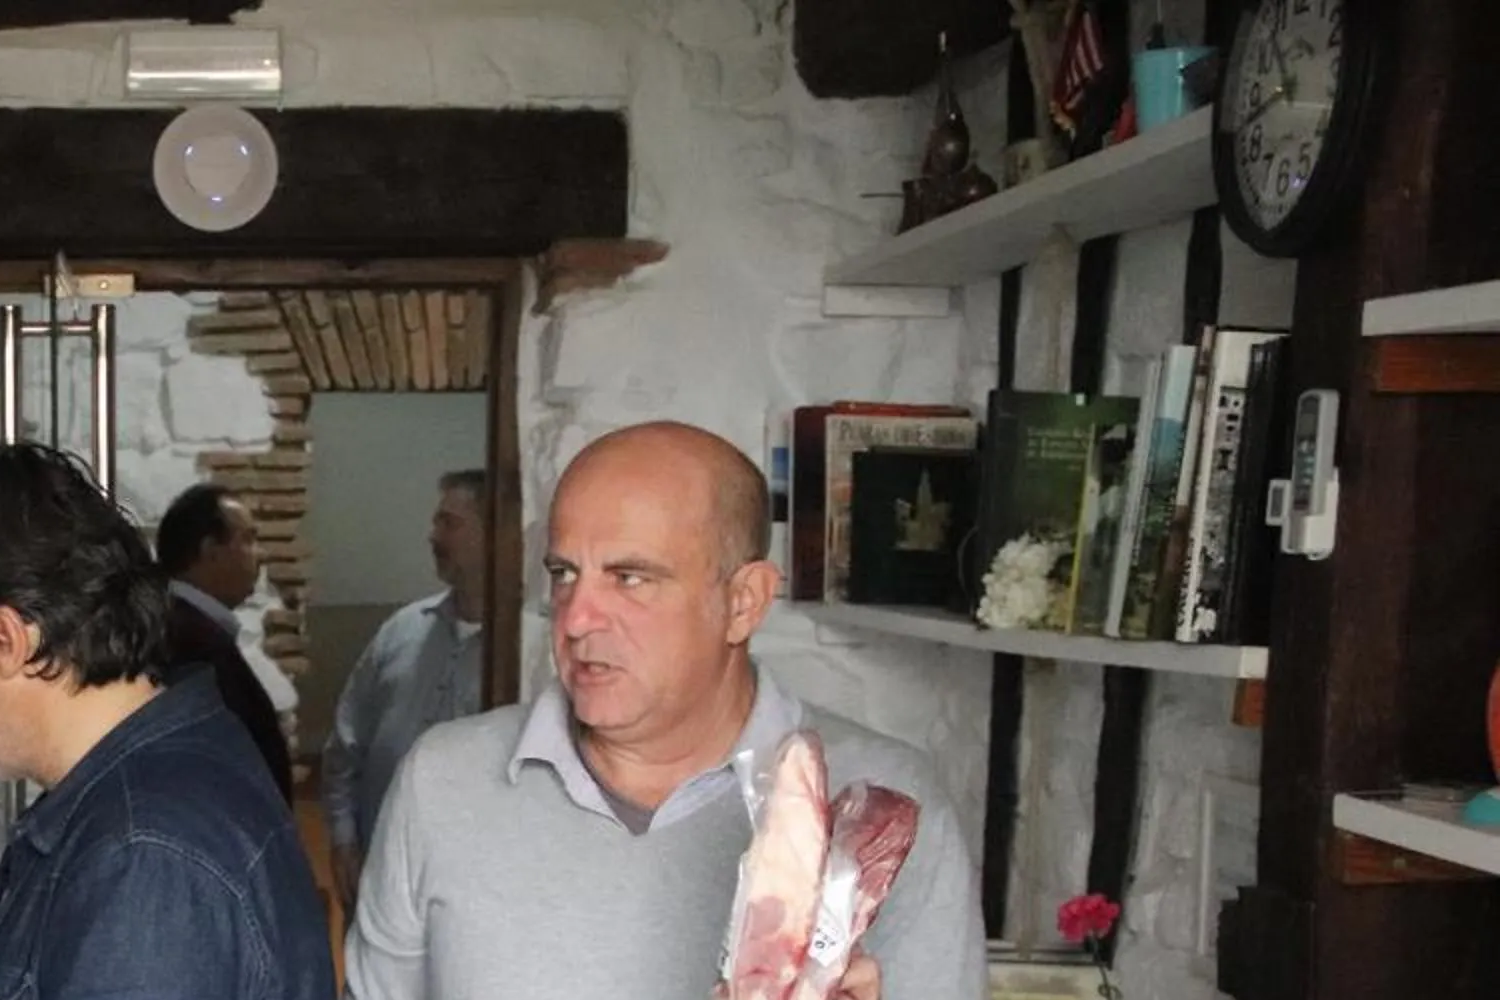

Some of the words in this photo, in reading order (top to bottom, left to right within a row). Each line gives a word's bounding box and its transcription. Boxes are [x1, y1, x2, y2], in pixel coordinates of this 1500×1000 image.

[1257, 42, 1273, 74] 10
[1249, 82, 1261, 107] 9
[1249, 124, 1263, 163] 8
[1296, 142, 1312, 181] 5
[1262, 152, 1275, 191] 7
[1276, 158, 1290, 197] 6
